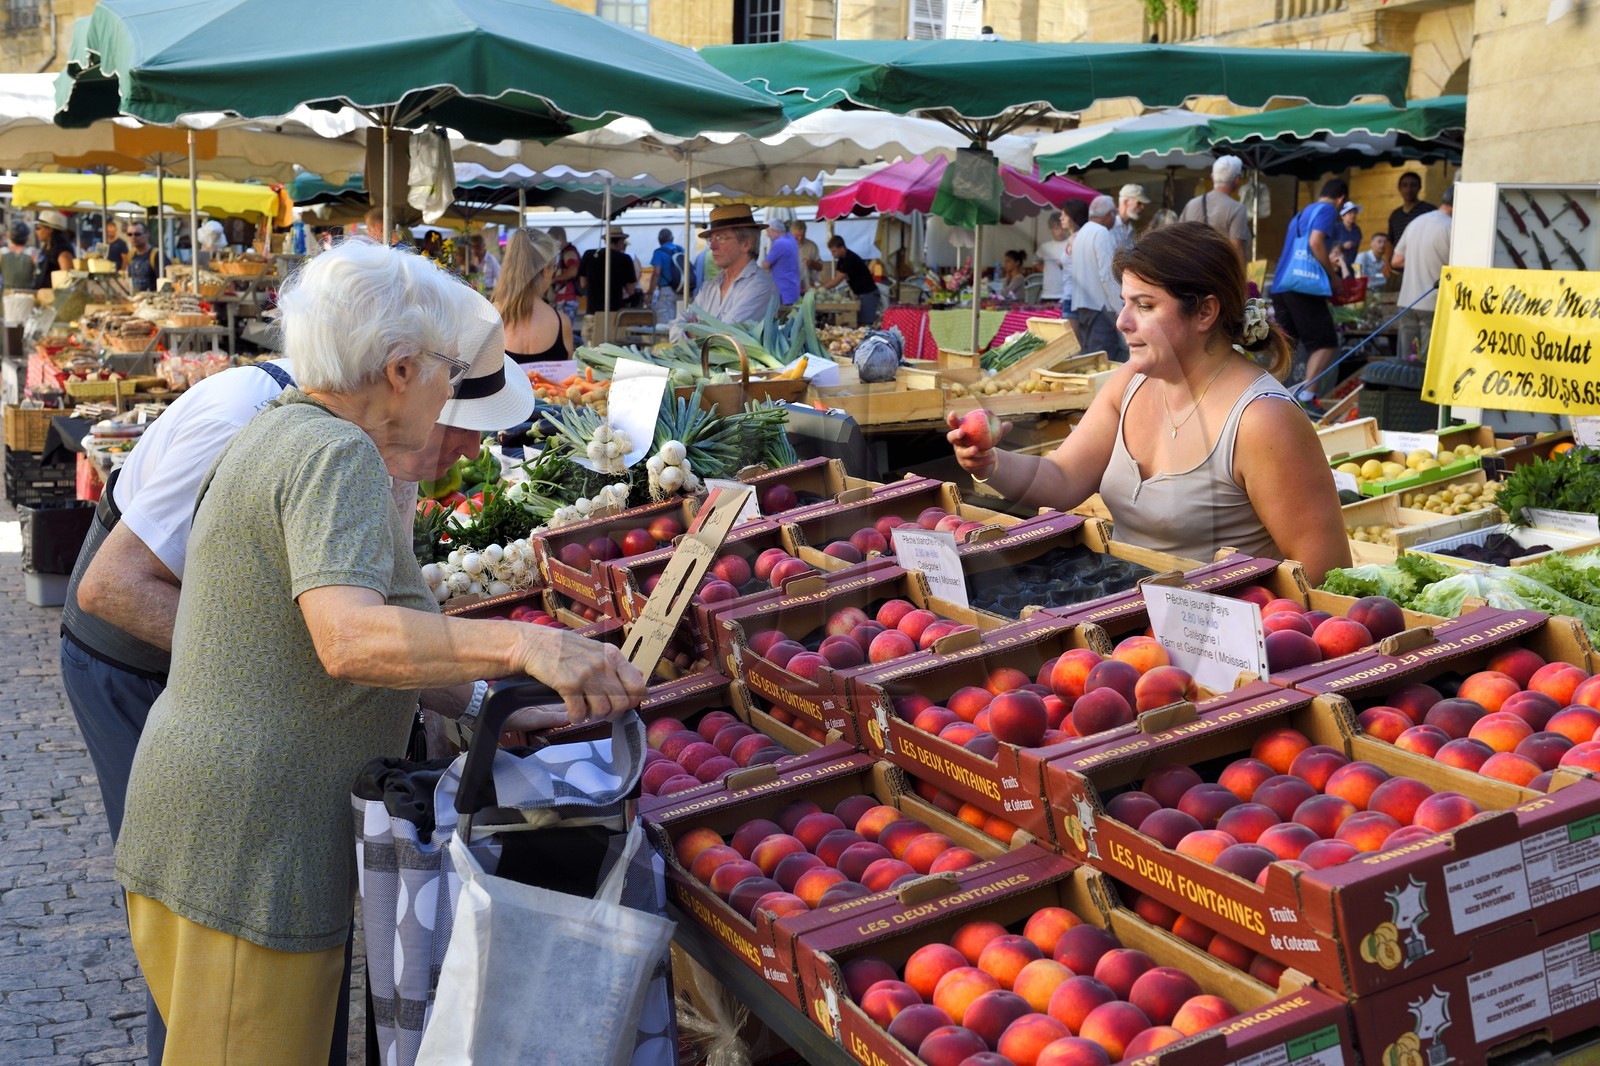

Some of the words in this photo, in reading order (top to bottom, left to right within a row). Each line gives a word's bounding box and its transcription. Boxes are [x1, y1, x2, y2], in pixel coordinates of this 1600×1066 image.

[1453, 282, 1476, 312] M.
[1480, 286, 1499, 315] &
[1500, 285, 1552, 317] Mme
[1471, 329, 1526, 357] 24200
[1531, 331, 1592, 365] Sarlat
[964, 542, 993, 553] DEUX
[994, 525, 1054, 547] FONTAINES
[1222, 565, 1259, 580] FRUIT
[1202, 578, 1220, 586] DU
[757, 602, 779, 612] LES
[780, 595, 812, 606] DEUX
[814, 577, 876, 599] FONTAINES
[1085, 600, 1147, 619] GARONNE
[1166, 592, 1189, 606] Pêche
[1190, 599, 1210, 612] jaune
[1211, 602, 1230, 616] Pays
[1019, 626, 1057, 640] FRUIT
[1184, 626, 1216, 644] Catégorie
[1487, 618, 1528, 638] FRUIT
[997, 636, 1018, 646] DU
[1160, 636, 1175, 648] Tarn
[1176, 641, 1184, 651] et
[1184, 642, 1214, 660] Garonne
[1462, 634, 1484, 646] DU
[942, 654, 958, 662] ET
[959, 644, 997, 656] TARN
[1418, 642, 1462, 658] TARN
[1398, 654, 1419, 665] ET
[874, 659, 938, 681] GARONNE
[1326, 662, 1398, 688] GARONNE
[761, 677, 781, 700] DEUX
[781, 686, 822, 720] FONTAINES
[1244, 698, 1288, 716] FRUIT
[1218, 712, 1242, 724] DU
[1174, 720, 1218, 736] TARN
[1152, 734, 1174, 743] ET
[1074, 740, 1150, 768] GARONNE
[792, 772, 812, 782] DU
[815, 761, 855, 777] FRUIT
[898, 736, 917, 760] LES
[917, 746, 944, 772] DEUX
[944, 759, 1001, 802] FONTAINES
[752, 778, 790, 794] TARN
[1001, 776, 1019, 790] Fruits
[733, 790, 750, 800] ET
[660, 796, 728, 819] GARONNE
[1004, 800, 1012, 812] de
[1012, 799, 1034, 811] Coteaux
[1517, 798, 1554, 813] LES
[1108, 840, 1135, 871] LES
[1136, 854, 1176, 892] DEUX
[1177, 874, 1266, 936] FONTAINES
[858, 920, 890, 936] LES
[892, 904, 938, 924] DEUX
[938, 874, 1030, 908] FONTAINES
[1269, 907, 1297, 924] Fruits
[692, 896, 714, 927] DEUX
[712, 914, 762, 967] FONTAINES
[1270, 934, 1284, 950] de
[1283, 935, 1321, 952] Coteaux
[1218, 996, 1311, 1036] GARONNE
[850, 1032, 871, 1066] LES
